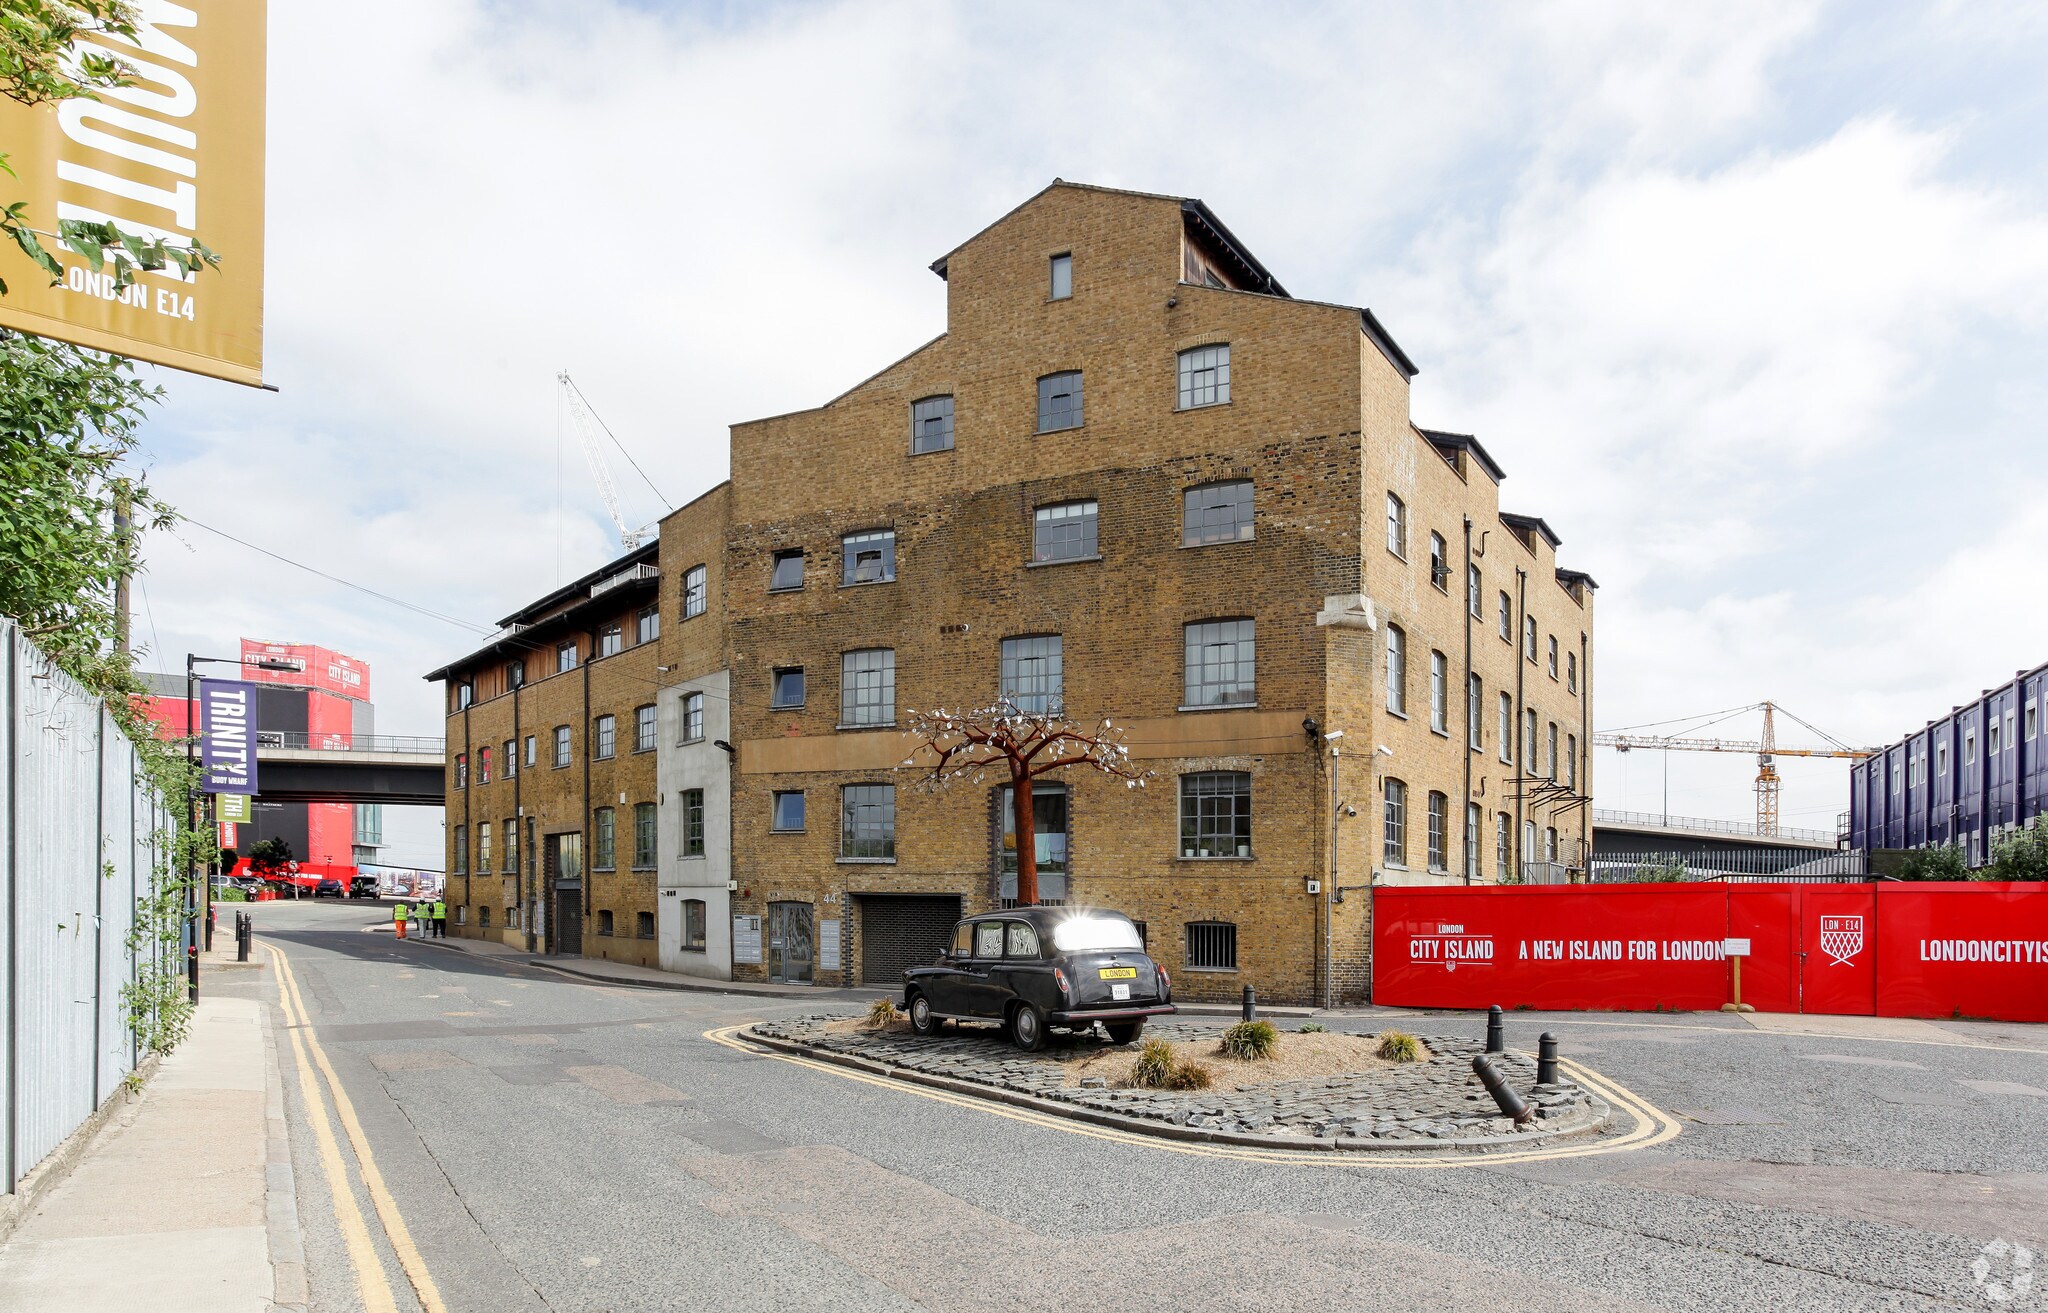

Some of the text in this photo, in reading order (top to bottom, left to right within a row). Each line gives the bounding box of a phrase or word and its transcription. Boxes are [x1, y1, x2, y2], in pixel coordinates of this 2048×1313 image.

[157, 287, 195, 321] E14
[328, 665, 361, 686] CITY ISLAND
[210, 690, 247, 776] TRINITY
[823, 893, 836, 903] 44
[1438, 924, 1464, 934] LONDON
[1825, 920, 1858, 930] LON E14
[1410, 940, 1494, 959] CITY ISLAND
[1518, 940, 1725, 961] A NEW ISLAND FOR LONDON
